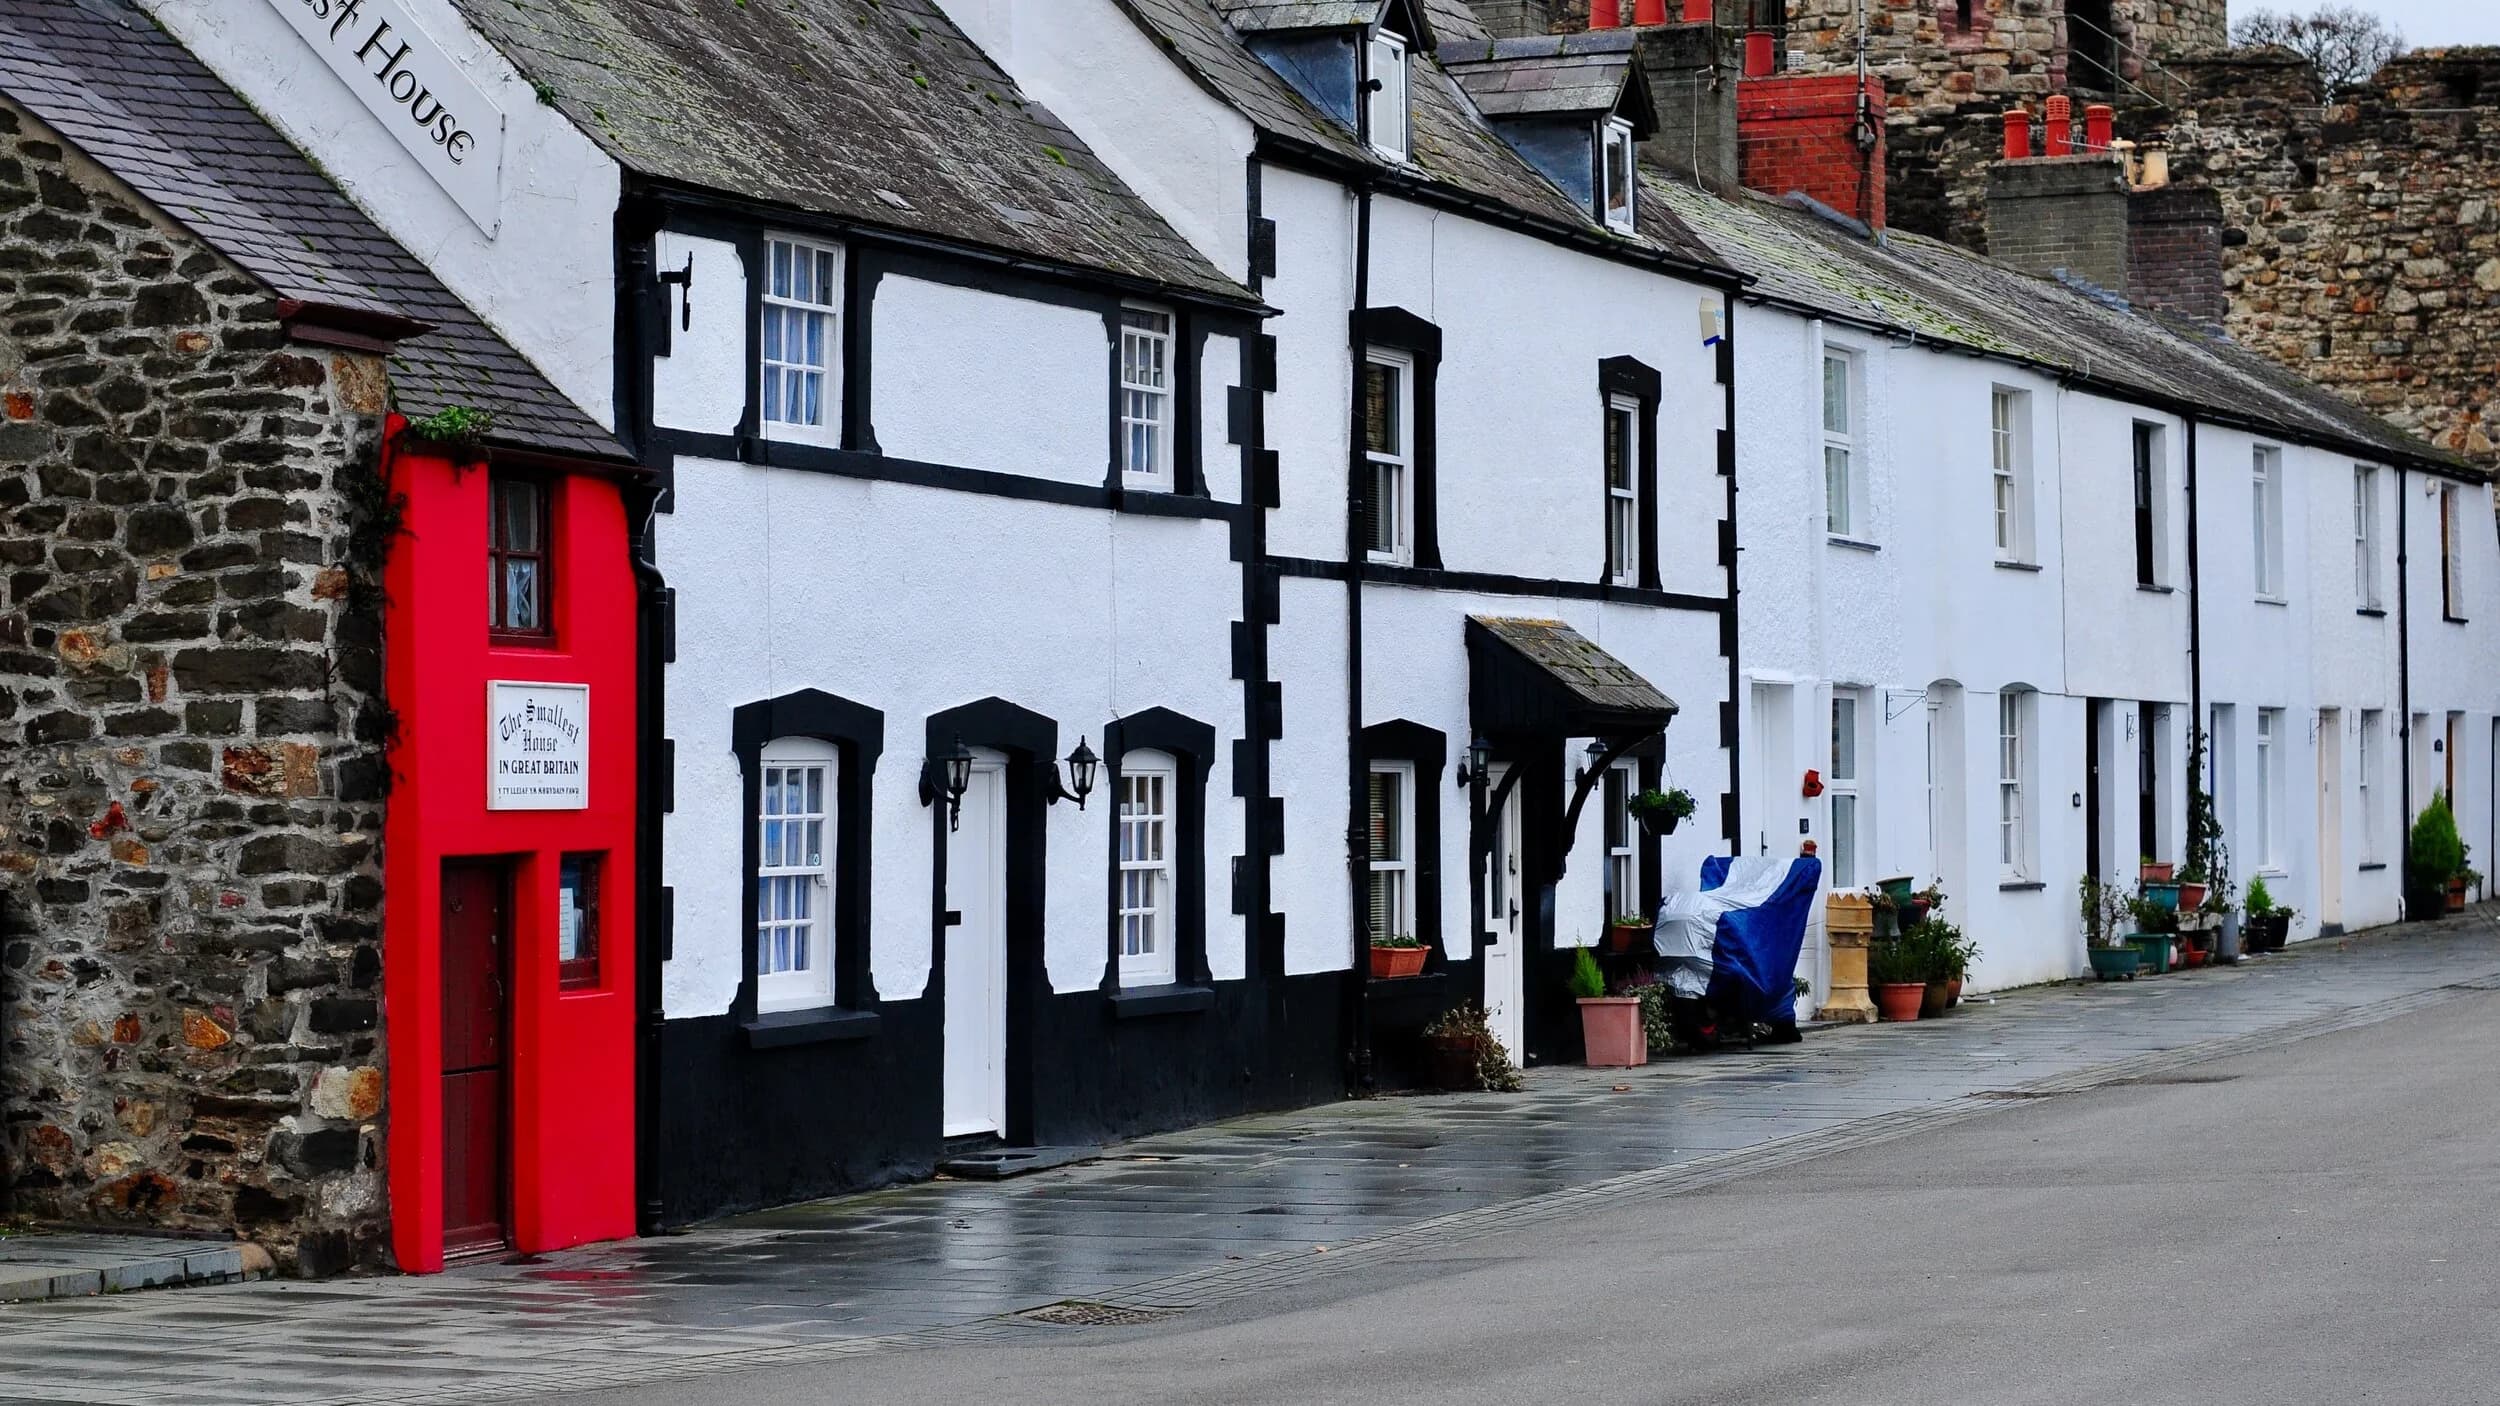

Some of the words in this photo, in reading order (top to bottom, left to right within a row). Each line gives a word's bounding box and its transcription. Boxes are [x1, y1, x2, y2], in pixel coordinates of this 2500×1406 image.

[499, 712, 522, 741] The
[526, 698, 579, 744] Smallest
[522, 729, 558, 752] House
[499, 759, 509, 774] IN
[511, 759, 541, 774] GREAT
[543, 760, 579, 774] BRITAIN
